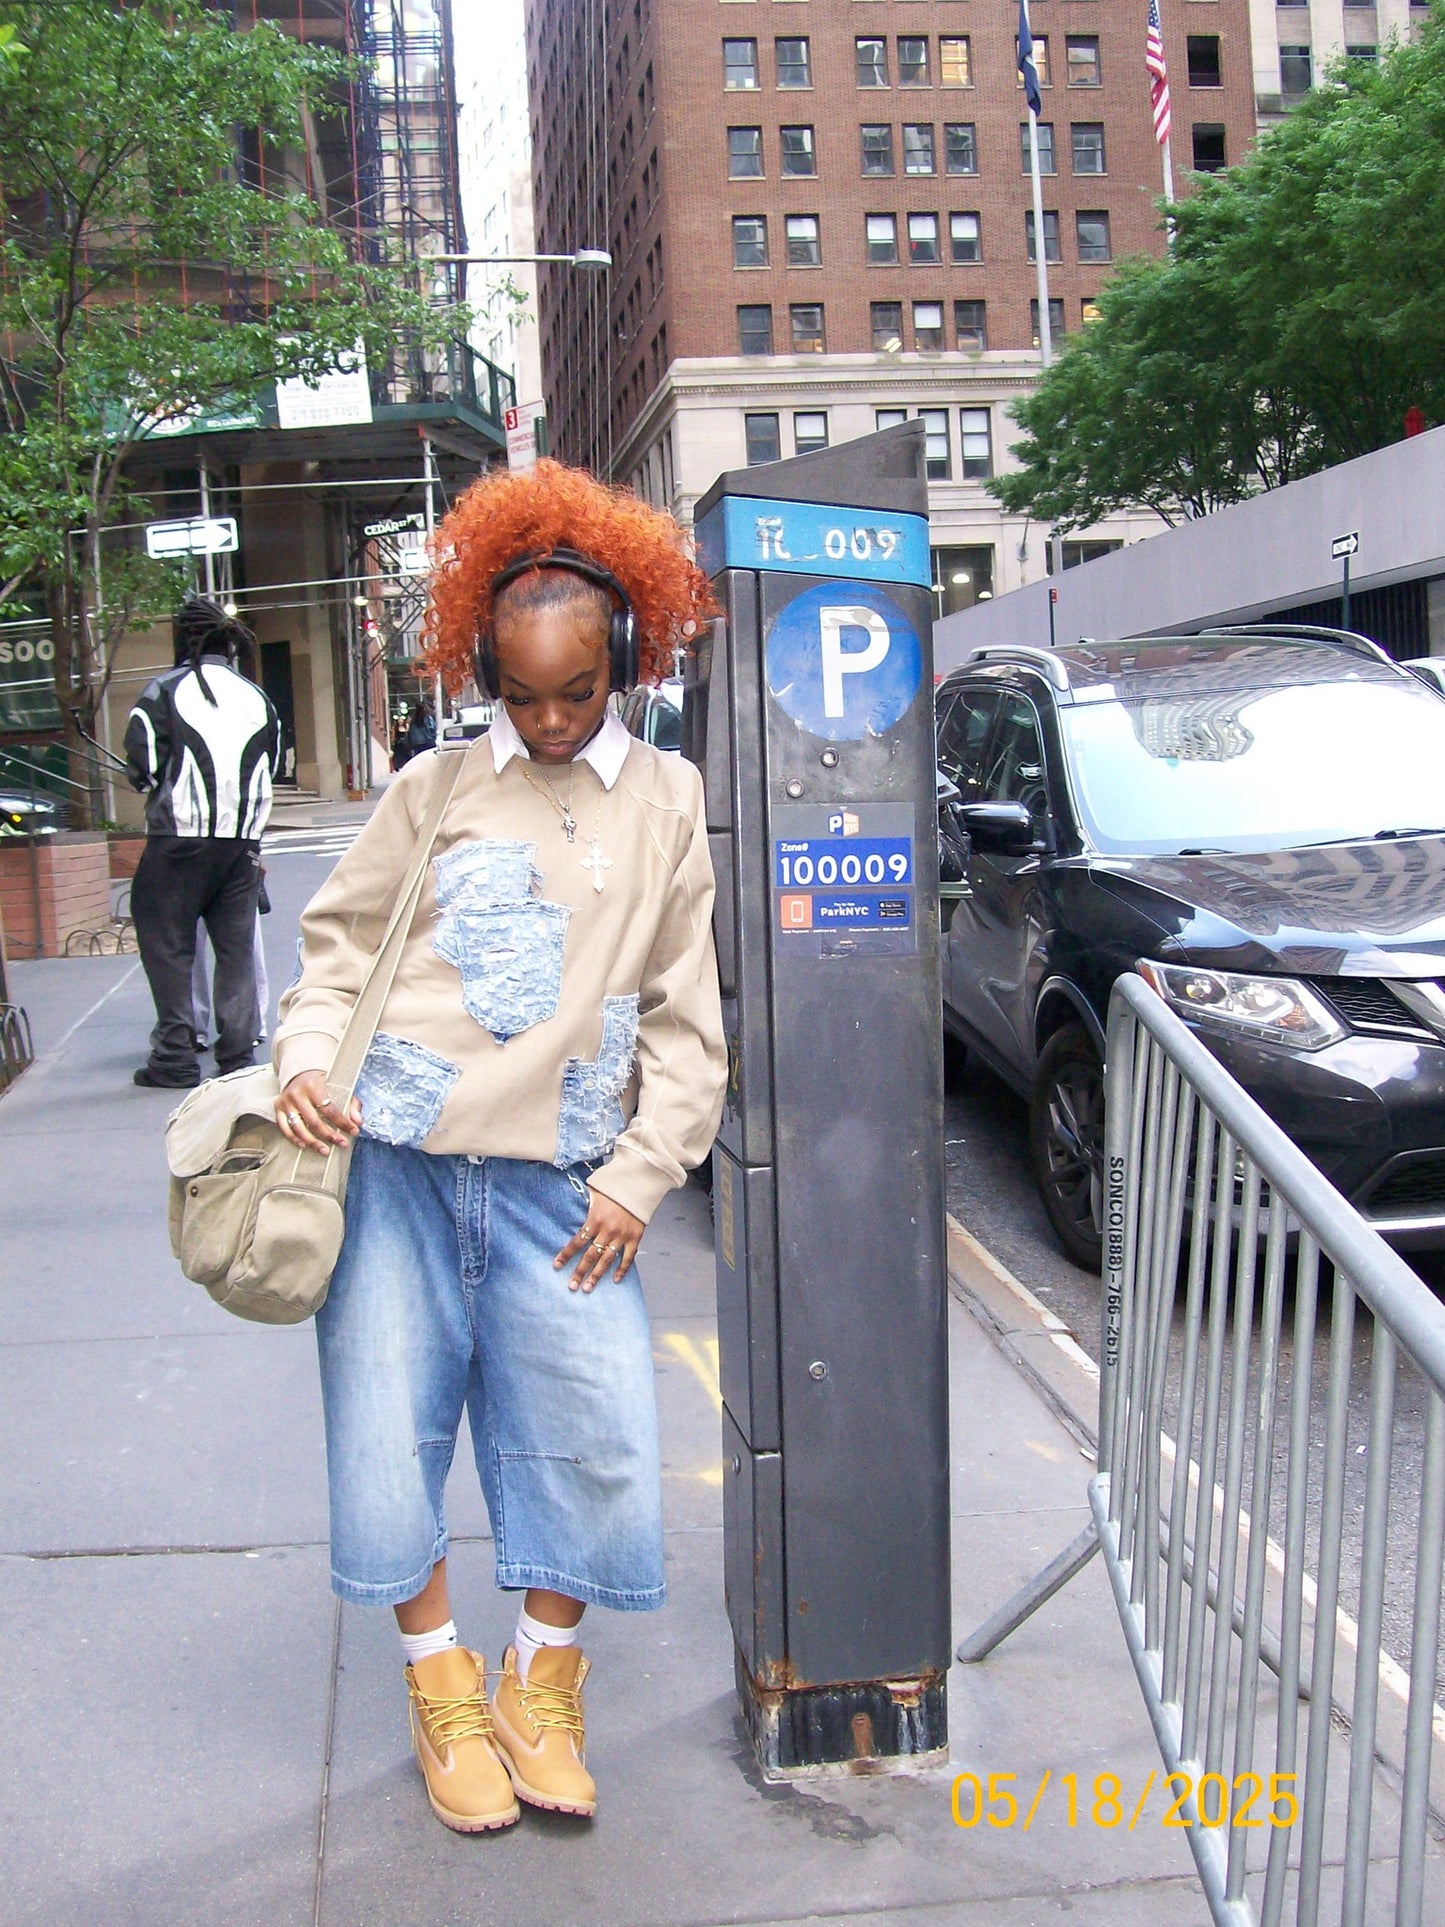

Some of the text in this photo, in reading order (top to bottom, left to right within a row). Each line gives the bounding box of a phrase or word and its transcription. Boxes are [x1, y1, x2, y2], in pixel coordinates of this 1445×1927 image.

[508, 411, 516, 428] 3
[364, 521, 400, 536] CEDAR
[819, 606, 890, 718] P
[829, 815, 842, 832] P
[781, 843, 809, 852] Zone#
[780, 853, 908, 885] 100009
[820, 906, 869, 917] ParkNYC
